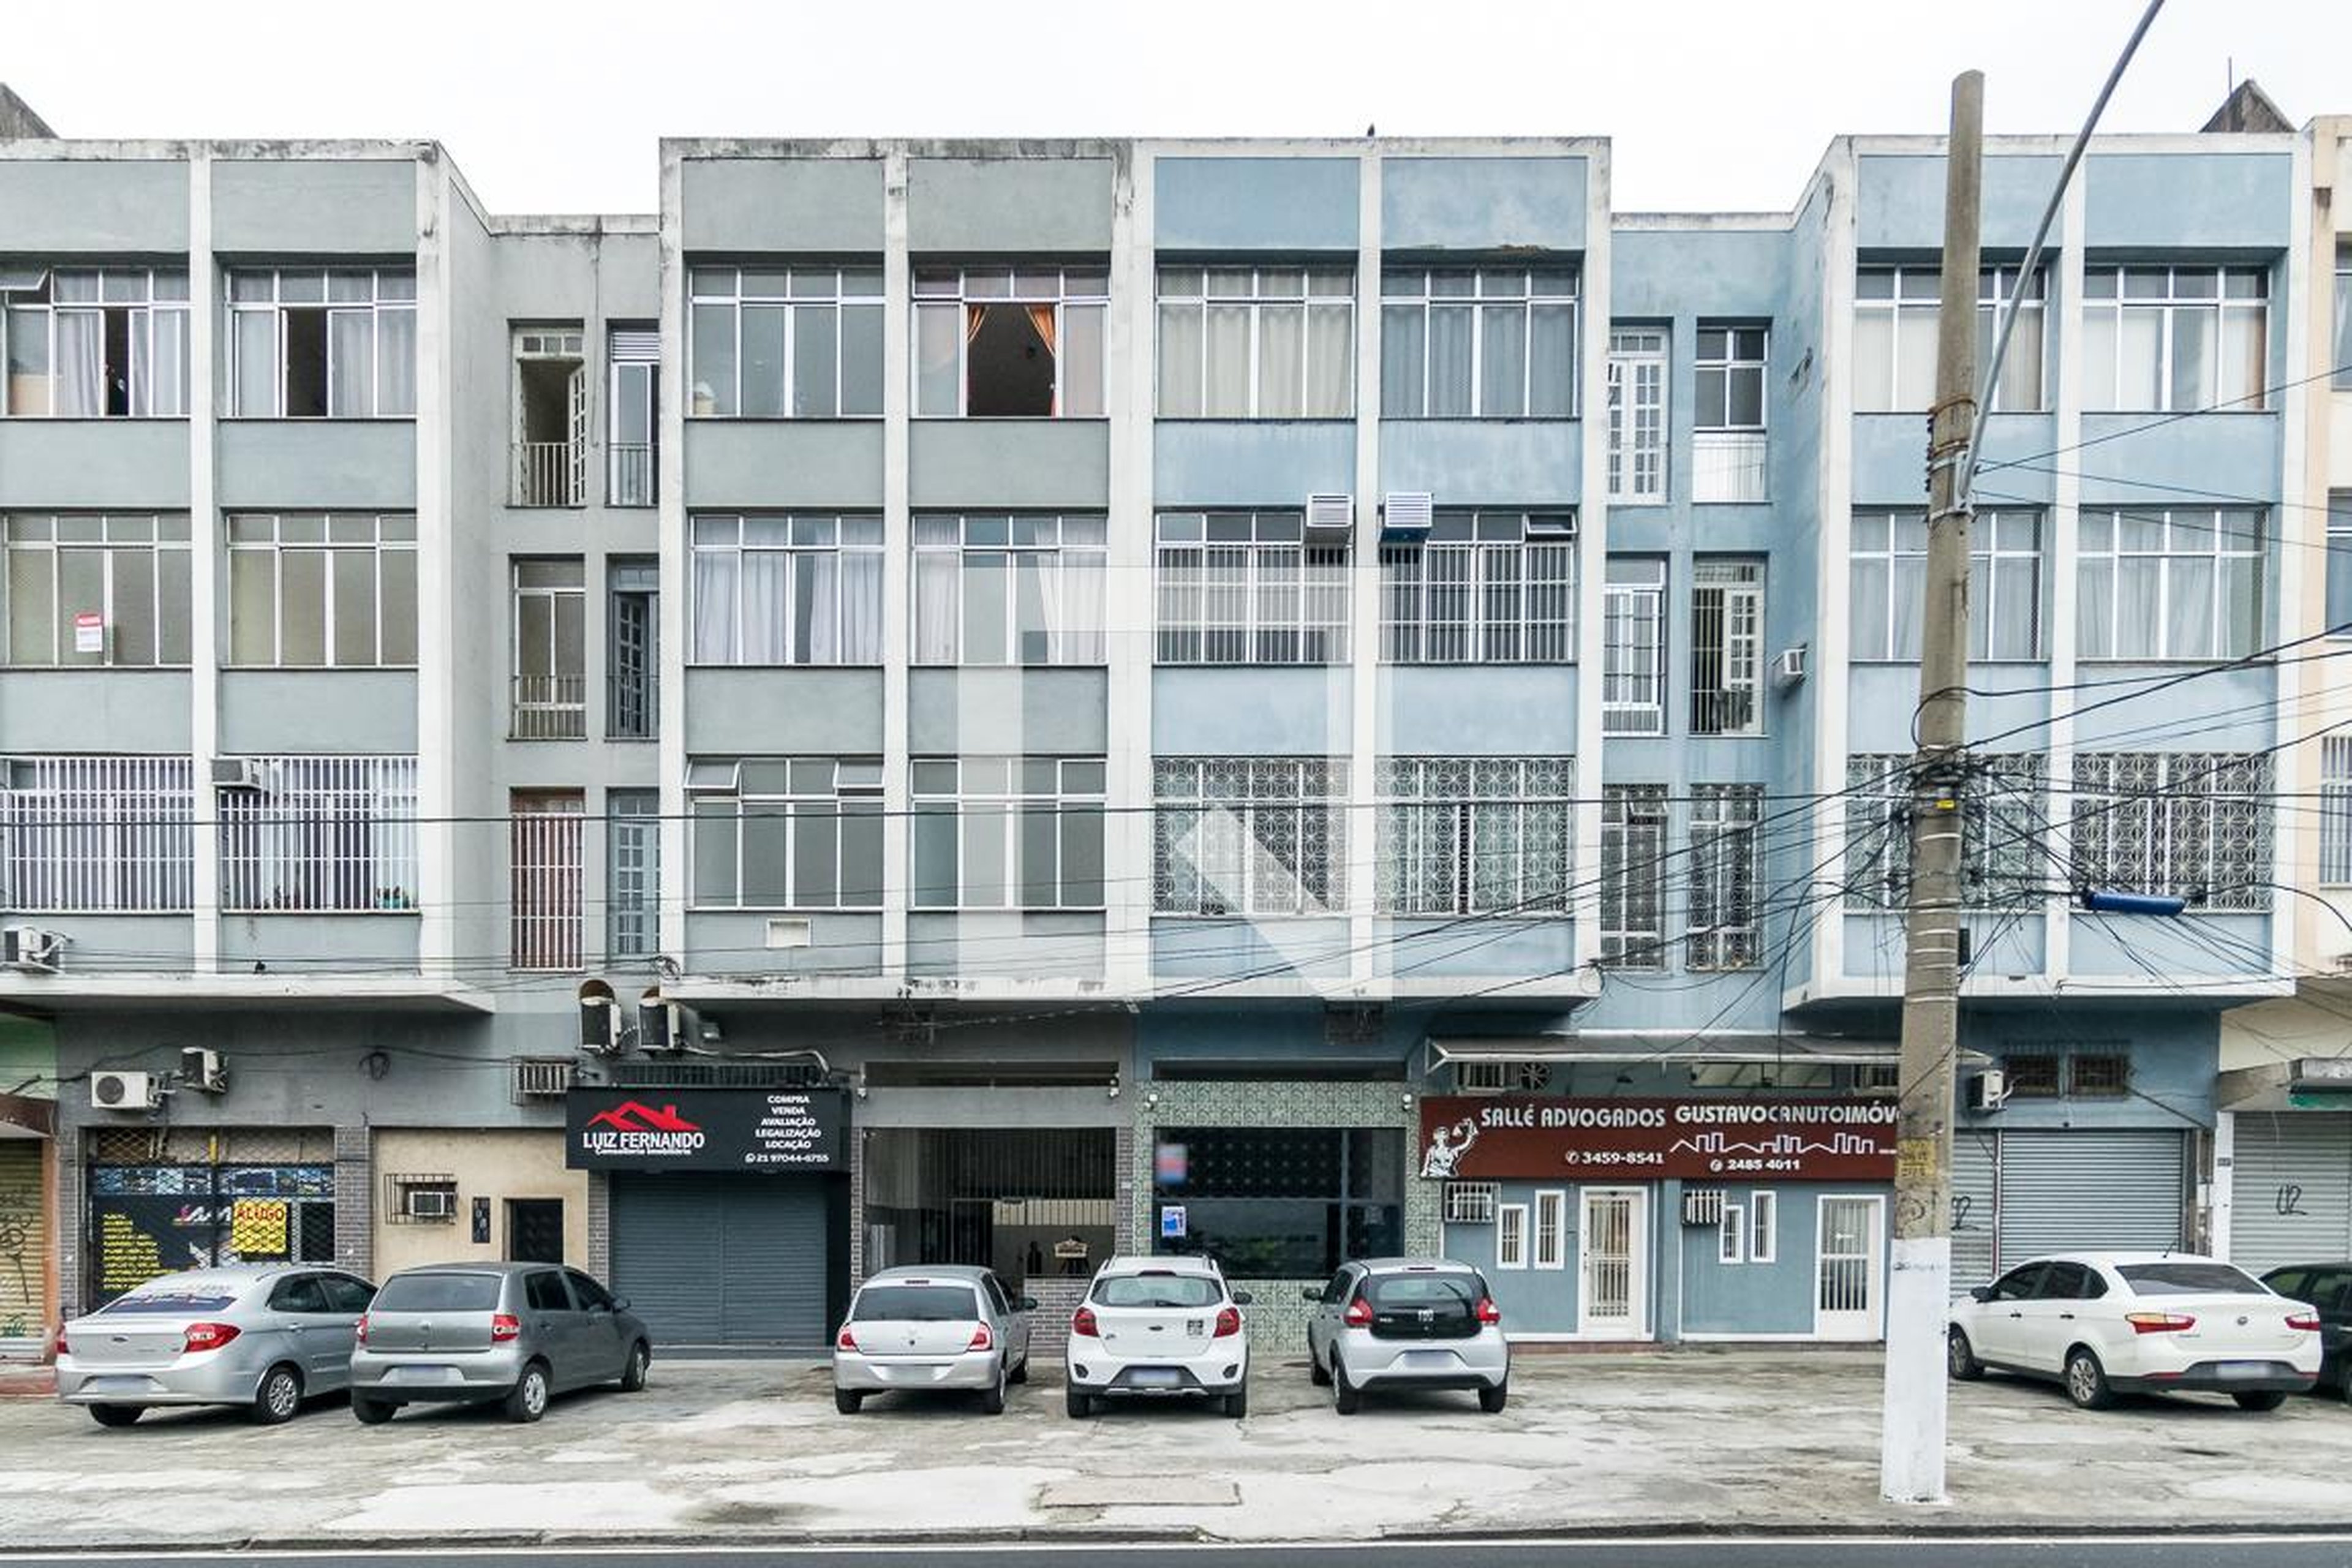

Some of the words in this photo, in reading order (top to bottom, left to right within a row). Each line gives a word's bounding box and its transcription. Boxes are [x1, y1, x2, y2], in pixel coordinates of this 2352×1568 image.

[767, 1095, 810, 1103] COMPRA
[771, 1106, 806, 1115] VENDA
[1481, 1104, 1534, 1127] SALLÉ
[1541, 1108, 1665, 1128] ADVOGADOS
[761, 1116, 816, 1127] AVALIAÇÃO
[755, 1127, 821, 1139] LEGALIZAÇÃO
[583, 1132, 617, 1150] LUIZ
[620, 1132, 705, 1149] FERNANDO
[765, 1140, 812, 1150] LOCAÇÃO
[1581, 1152, 1665, 1164] 3459-8541
[1727, 1159, 1762, 1170] 2485
[1765, 1159, 1801, 1170] 4011
